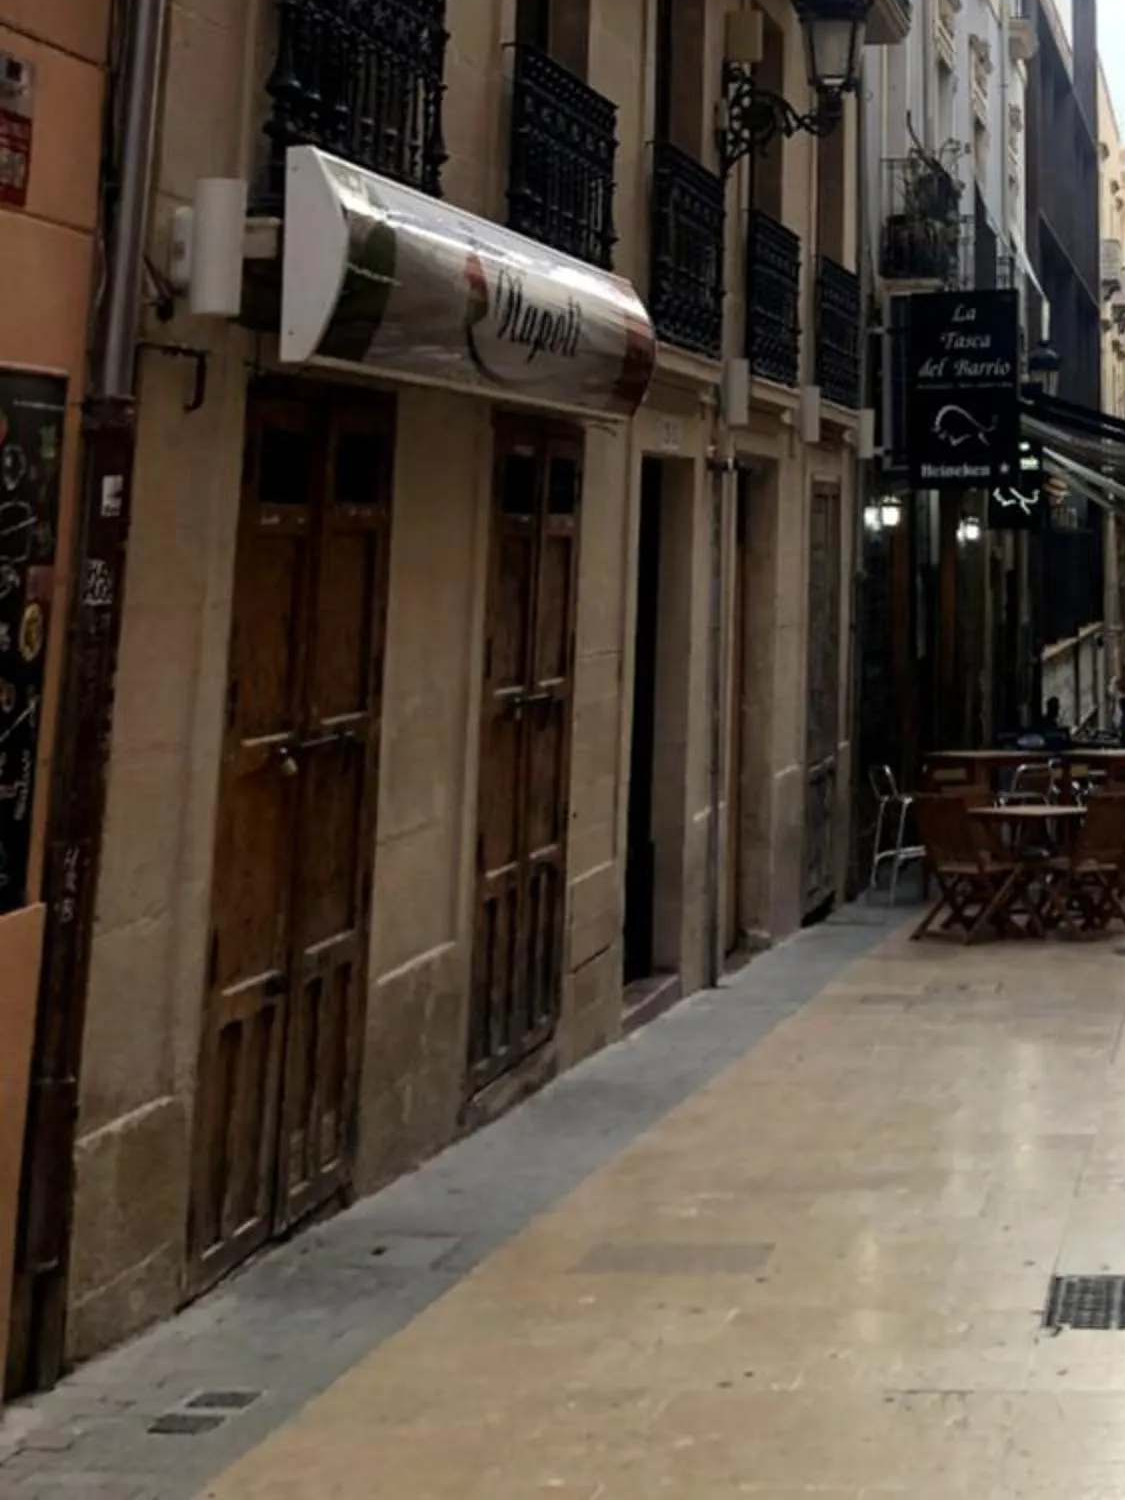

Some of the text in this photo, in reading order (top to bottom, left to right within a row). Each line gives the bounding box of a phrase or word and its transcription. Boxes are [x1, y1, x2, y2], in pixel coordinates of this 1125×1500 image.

[952, 304, 976, 322] La
[940, 331, 991, 350] Tasca
[918, 357, 1011, 378] del Barrio
[920, 462, 991, 478] Heineken
